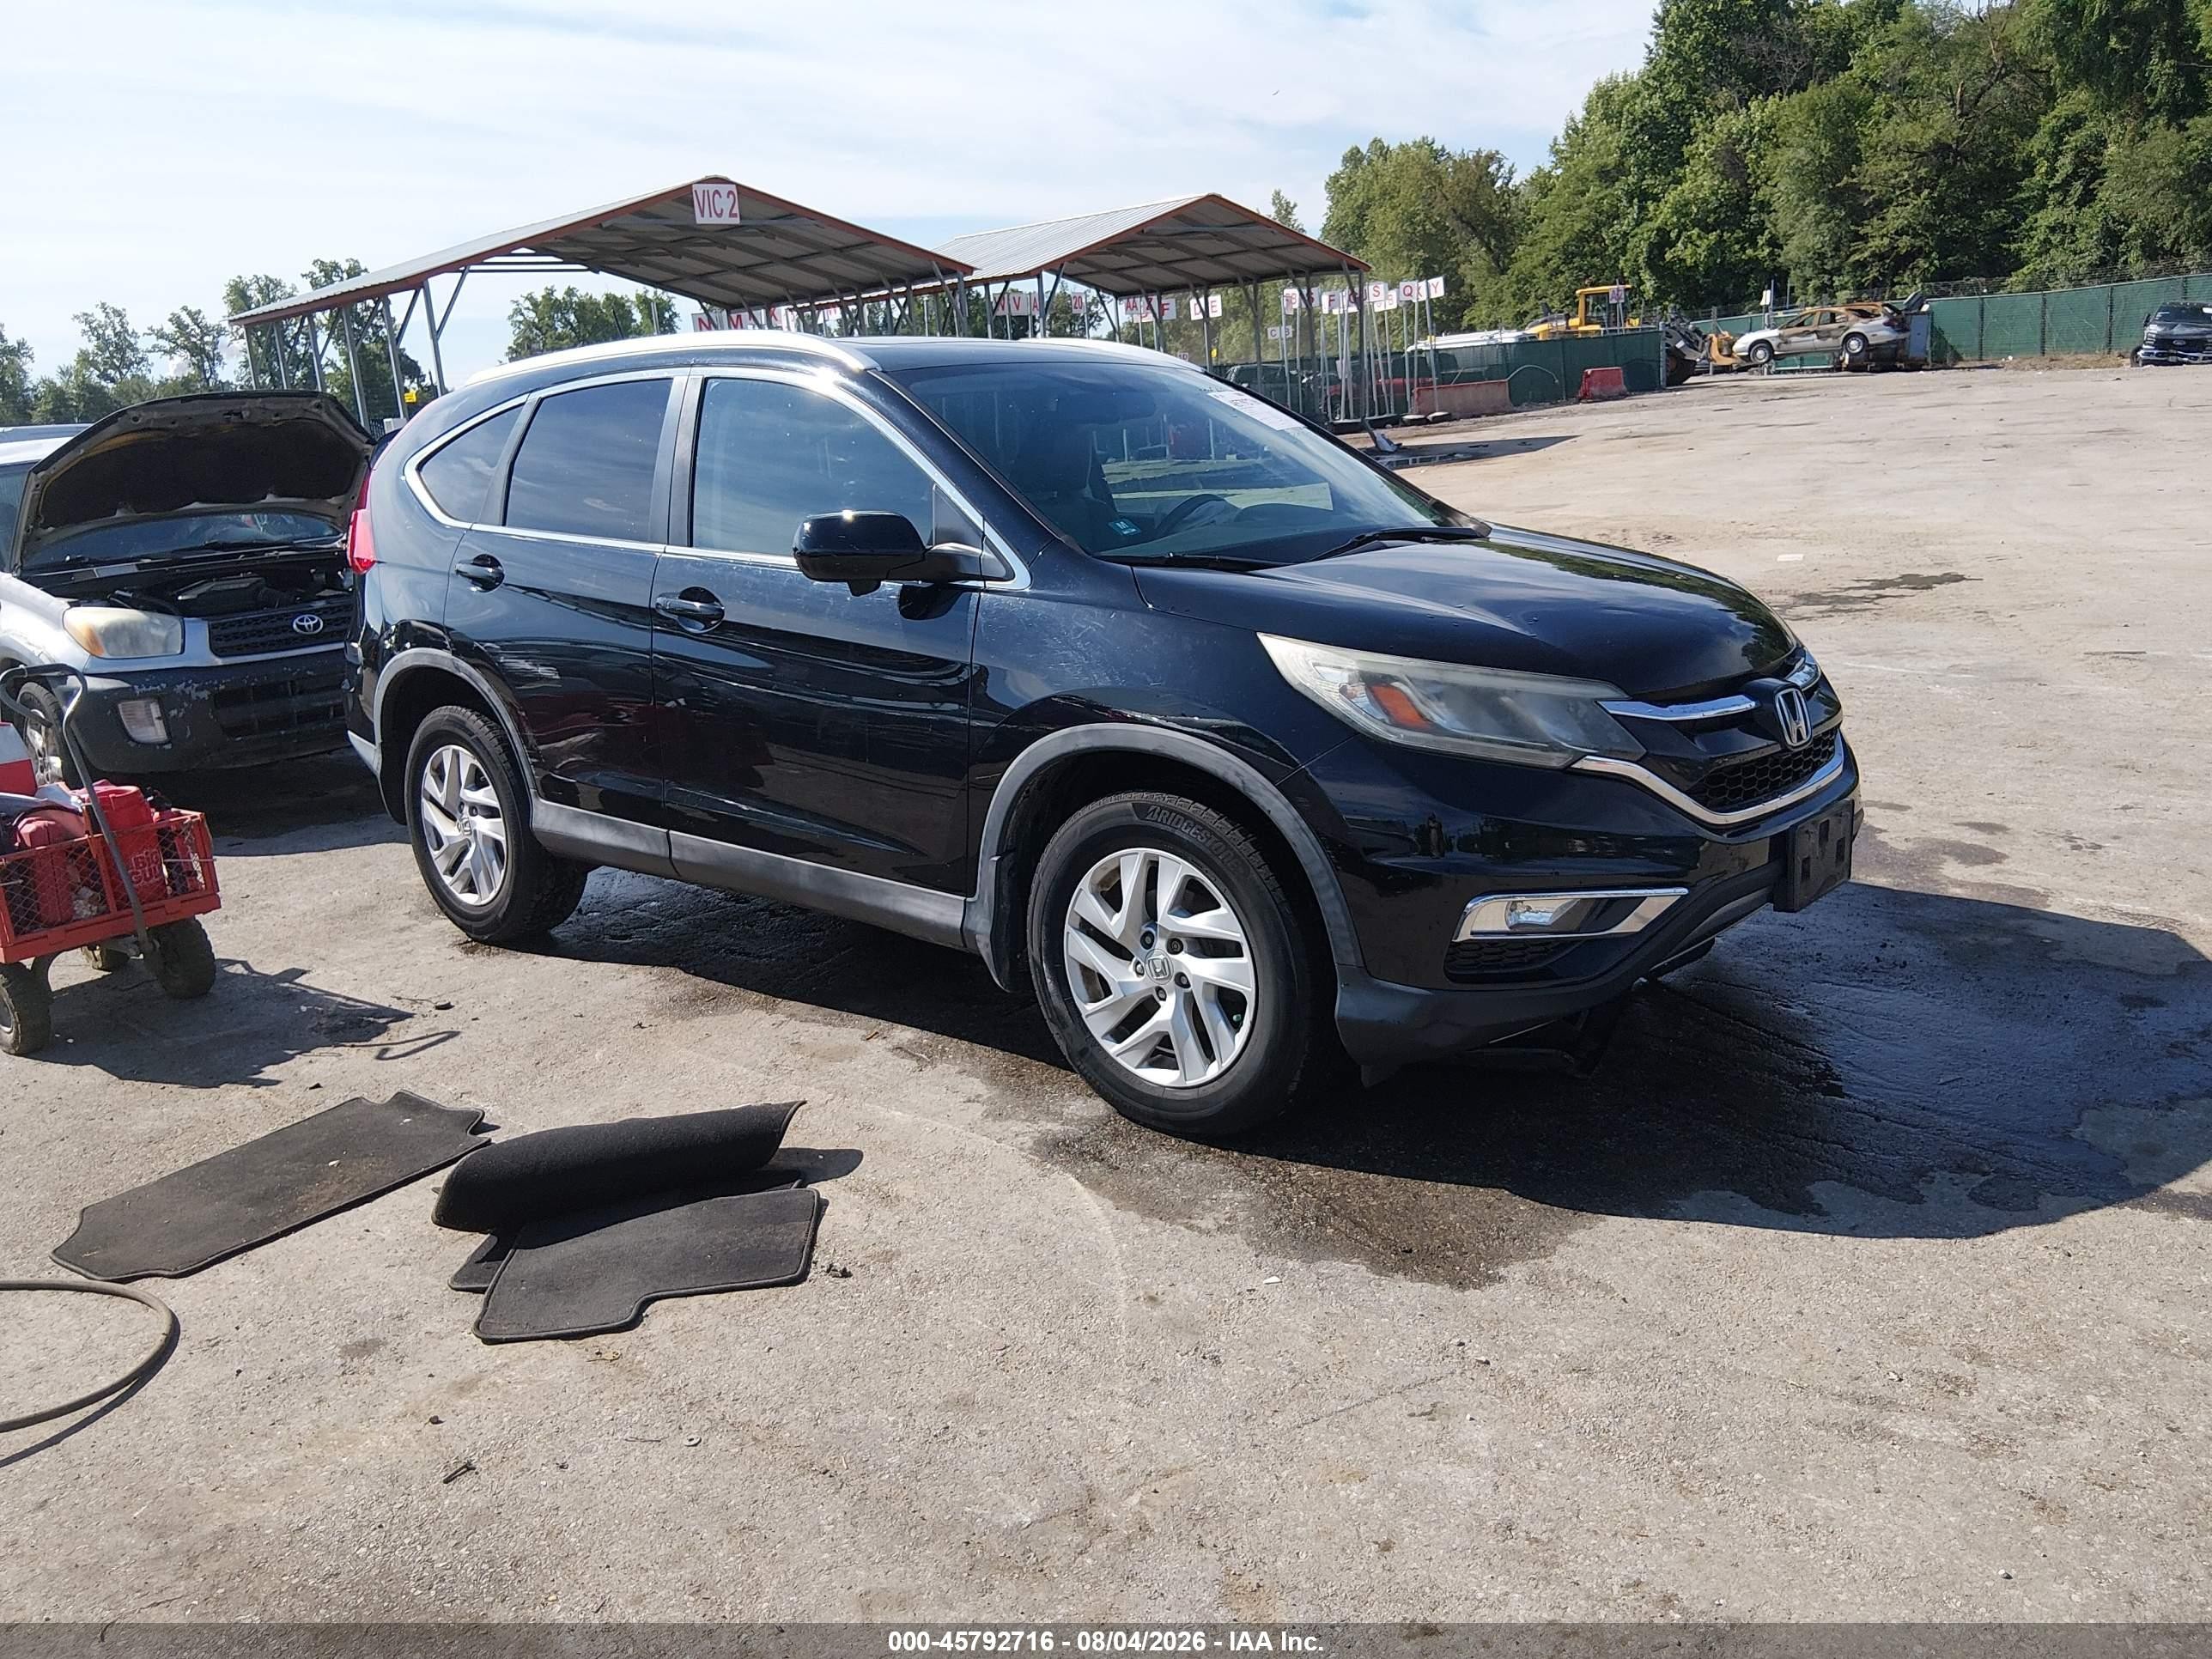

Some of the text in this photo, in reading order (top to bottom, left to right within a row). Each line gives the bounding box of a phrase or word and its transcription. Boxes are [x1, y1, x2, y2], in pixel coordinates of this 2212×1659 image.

[694, 189, 739, 219] VIC 2
[1372, 285, 1381, 298] S
[1402, 284, 1413, 297] Q
[1013, 296, 1021, 311] V
[1073, 295, 1084, 310] 20
[1210, 301, 1218, 313] E
[1328, 295, 1336, 307] F
[1161, 302, 1170, 317] F
[697, 317, 713, 331] N
[728, 314, 744, 331] M
